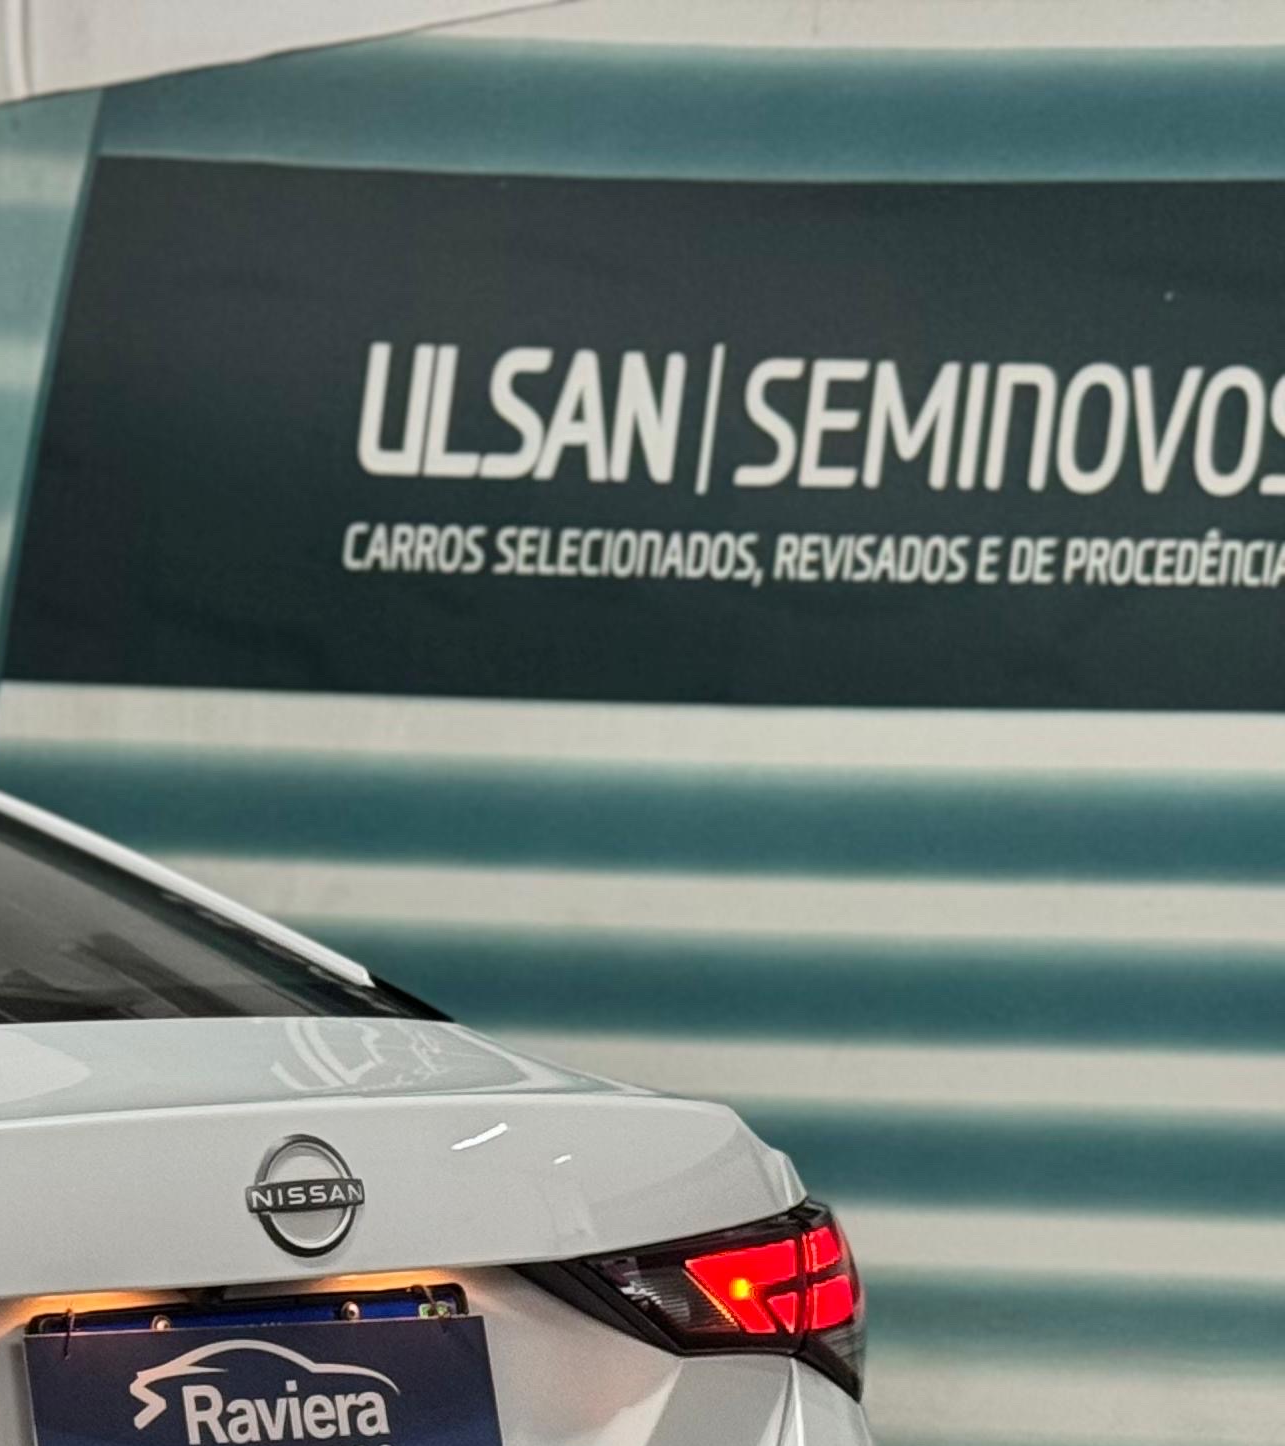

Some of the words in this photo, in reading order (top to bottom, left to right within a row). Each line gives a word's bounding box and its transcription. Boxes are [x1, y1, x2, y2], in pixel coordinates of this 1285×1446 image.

[358, 342, 686, 483] ULSAN
[343, 522, 486, 574] CARROS
[493, 526, 763, 587] SELECIONADOS,
[774, 533, 971, 585] REVISADOS
[976, 535, 1003, 584] E
[1008, 536, 1059, 585] DE
[251, 1183, 364, 1209] NISSAN
[182, 1379, 392, 1446] Raviera
